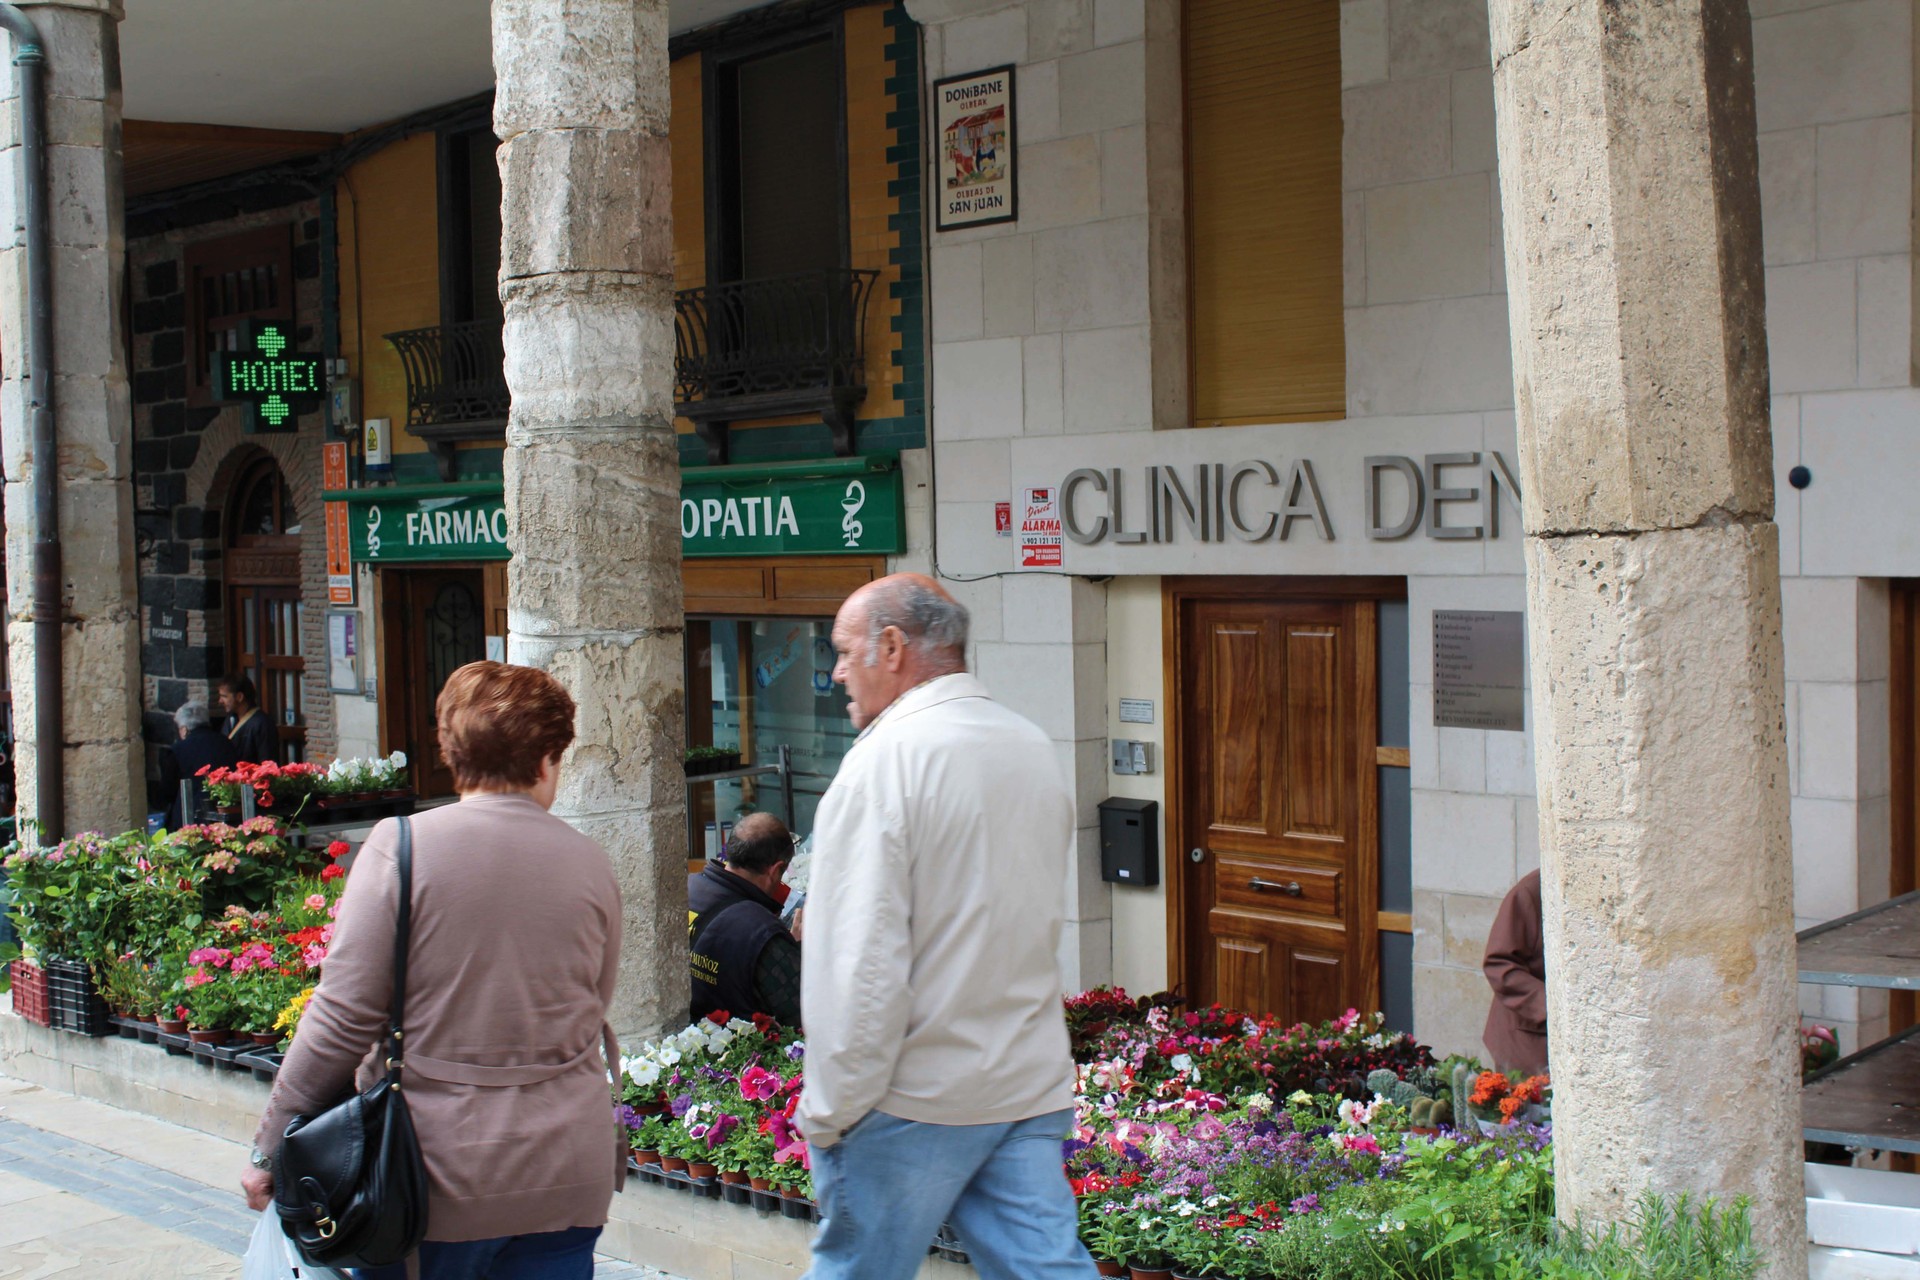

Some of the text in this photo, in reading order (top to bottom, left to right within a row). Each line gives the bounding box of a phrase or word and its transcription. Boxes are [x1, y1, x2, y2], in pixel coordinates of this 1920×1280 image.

[945, 80, 1003, 103] DONiBANE
[960, 98, 988, 110] OLBEAK
[956, 185, 995, 199] OLBEAS DE
[949, 195, 1003, 214] SAN jUAN
[1059, 451, 1524, 544] CLINICA DEN
[406, 496, 800, 546] FARMAC OPATIA
[1022, 520, 1060, 531] ALARMA
